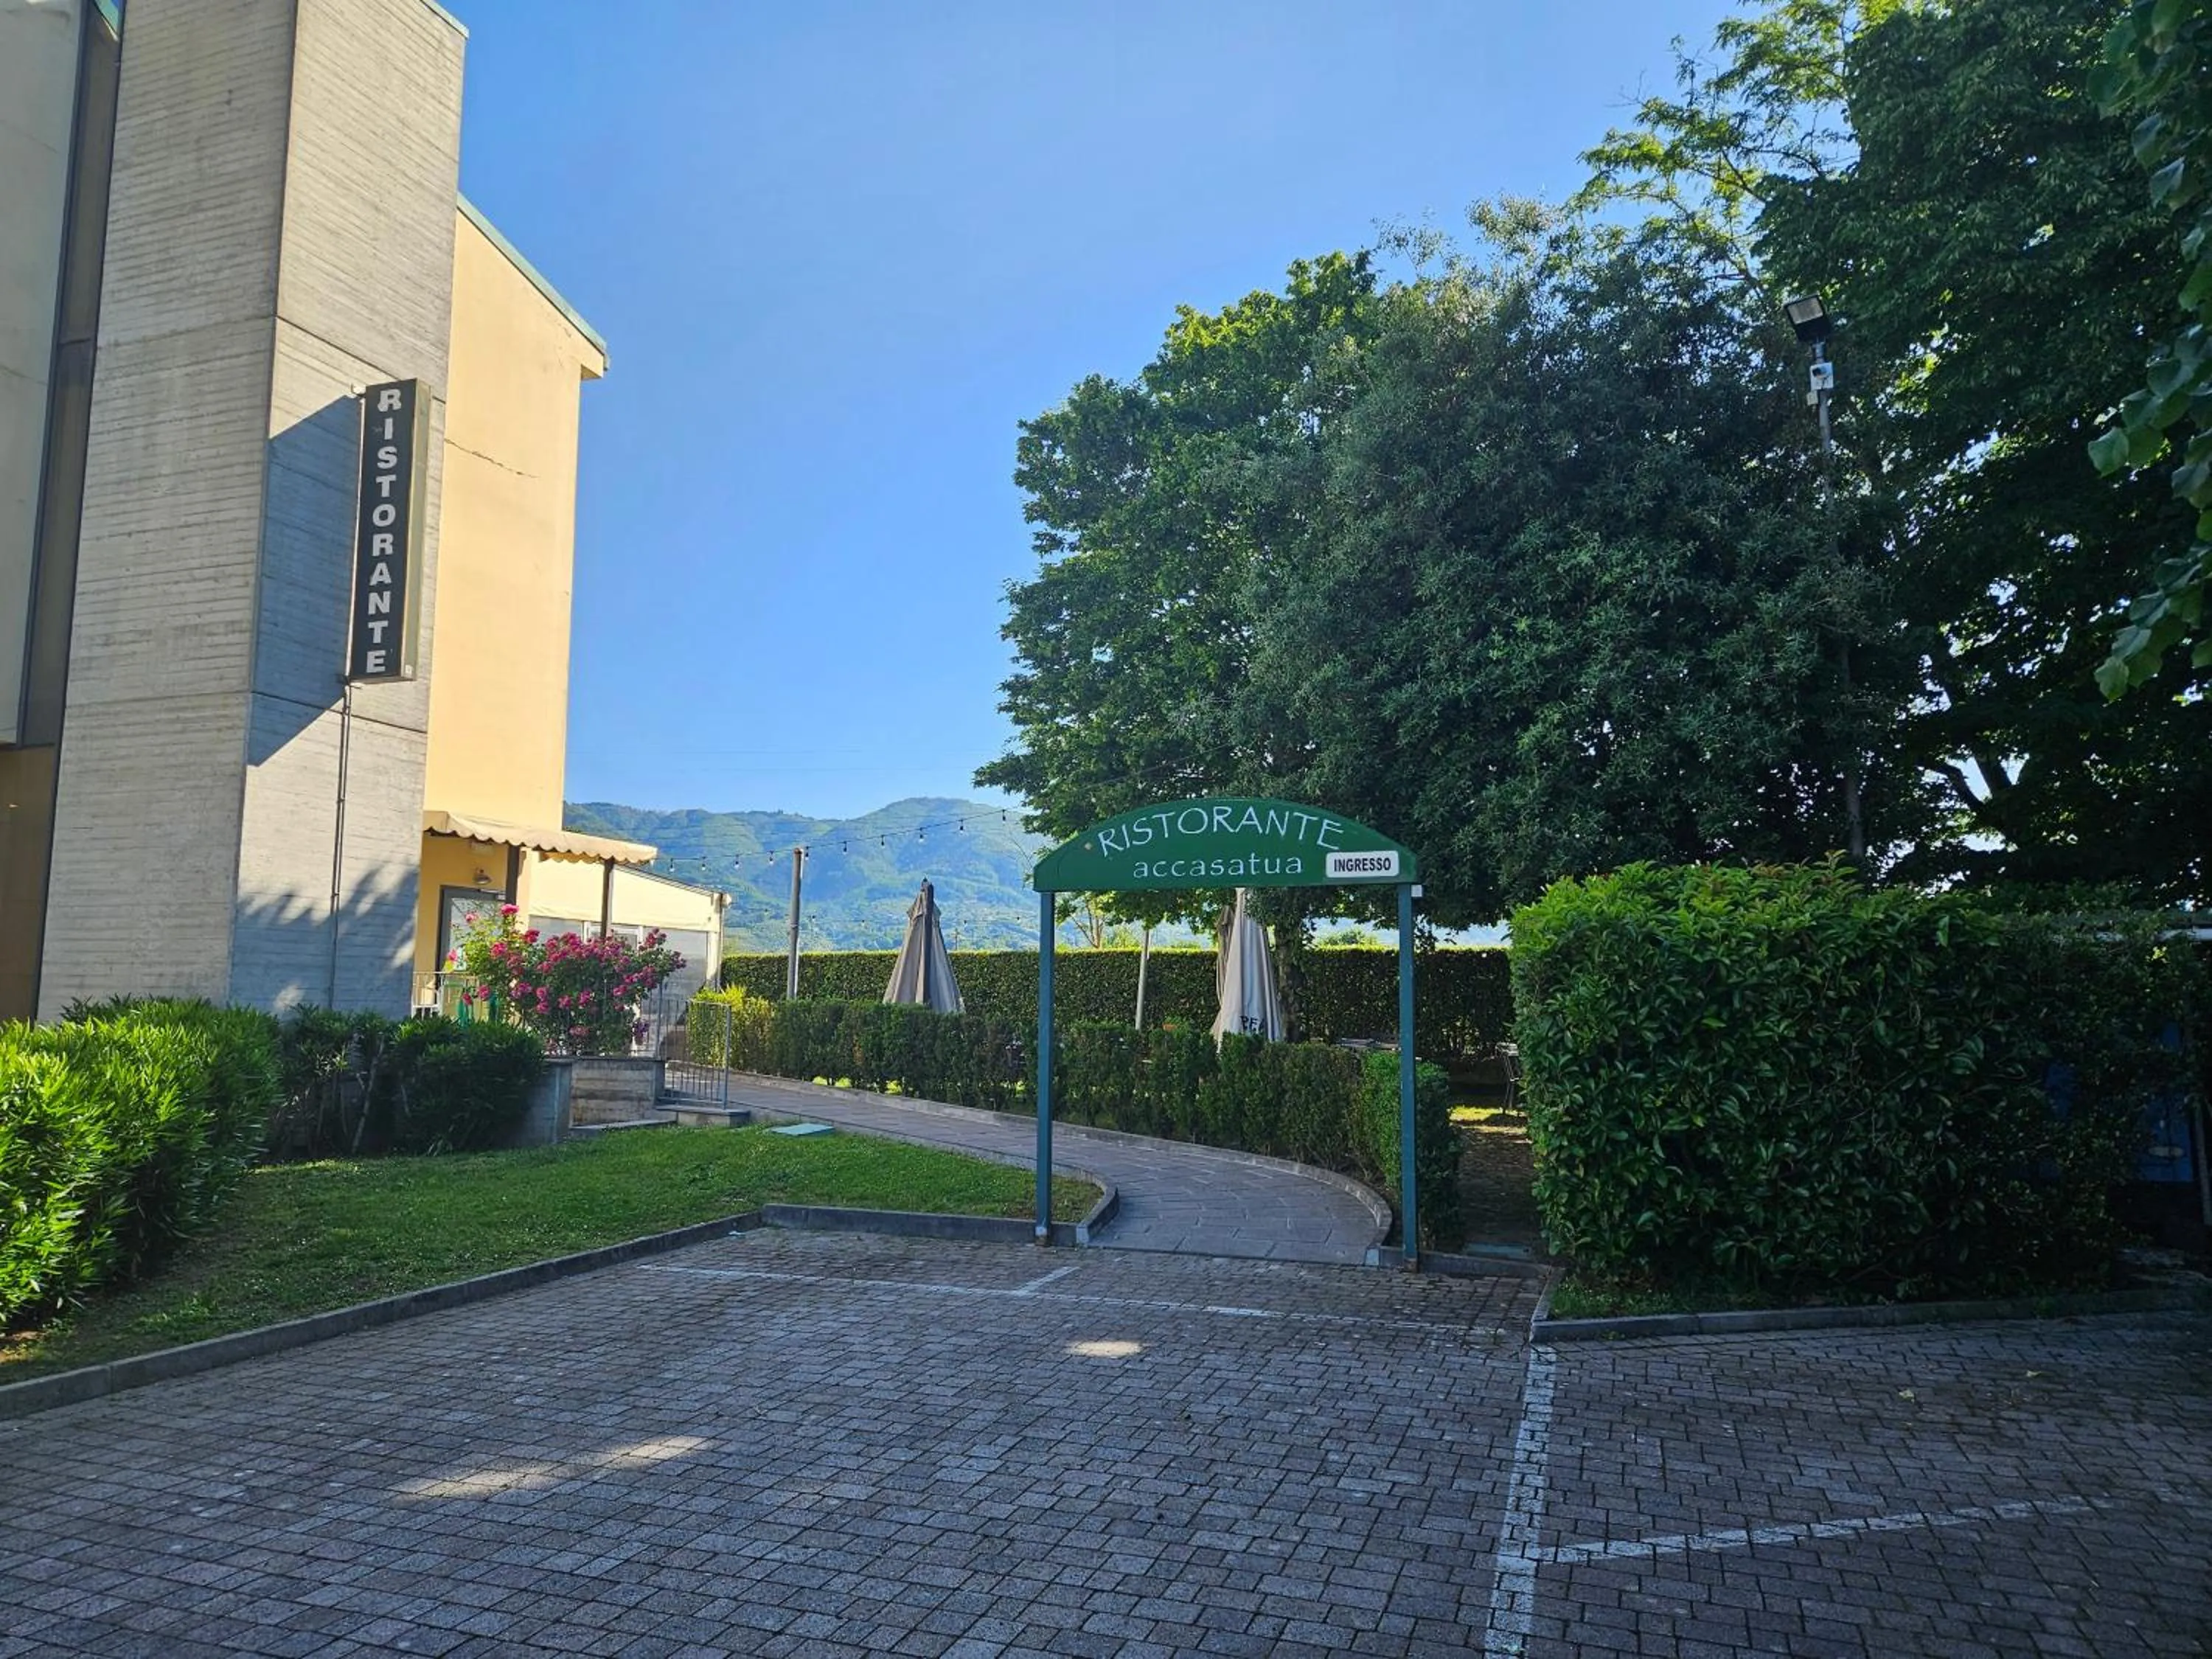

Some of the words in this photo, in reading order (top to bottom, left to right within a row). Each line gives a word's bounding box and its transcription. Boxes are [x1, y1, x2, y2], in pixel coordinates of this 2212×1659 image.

[366, 389, 401, 674] RISTORANTE
[1099, 807, 1343, 855] RISTORANTE
[1133, 852, 1302, 878] accasatua
[1334, 858, 1391, 872] INGRESSO
